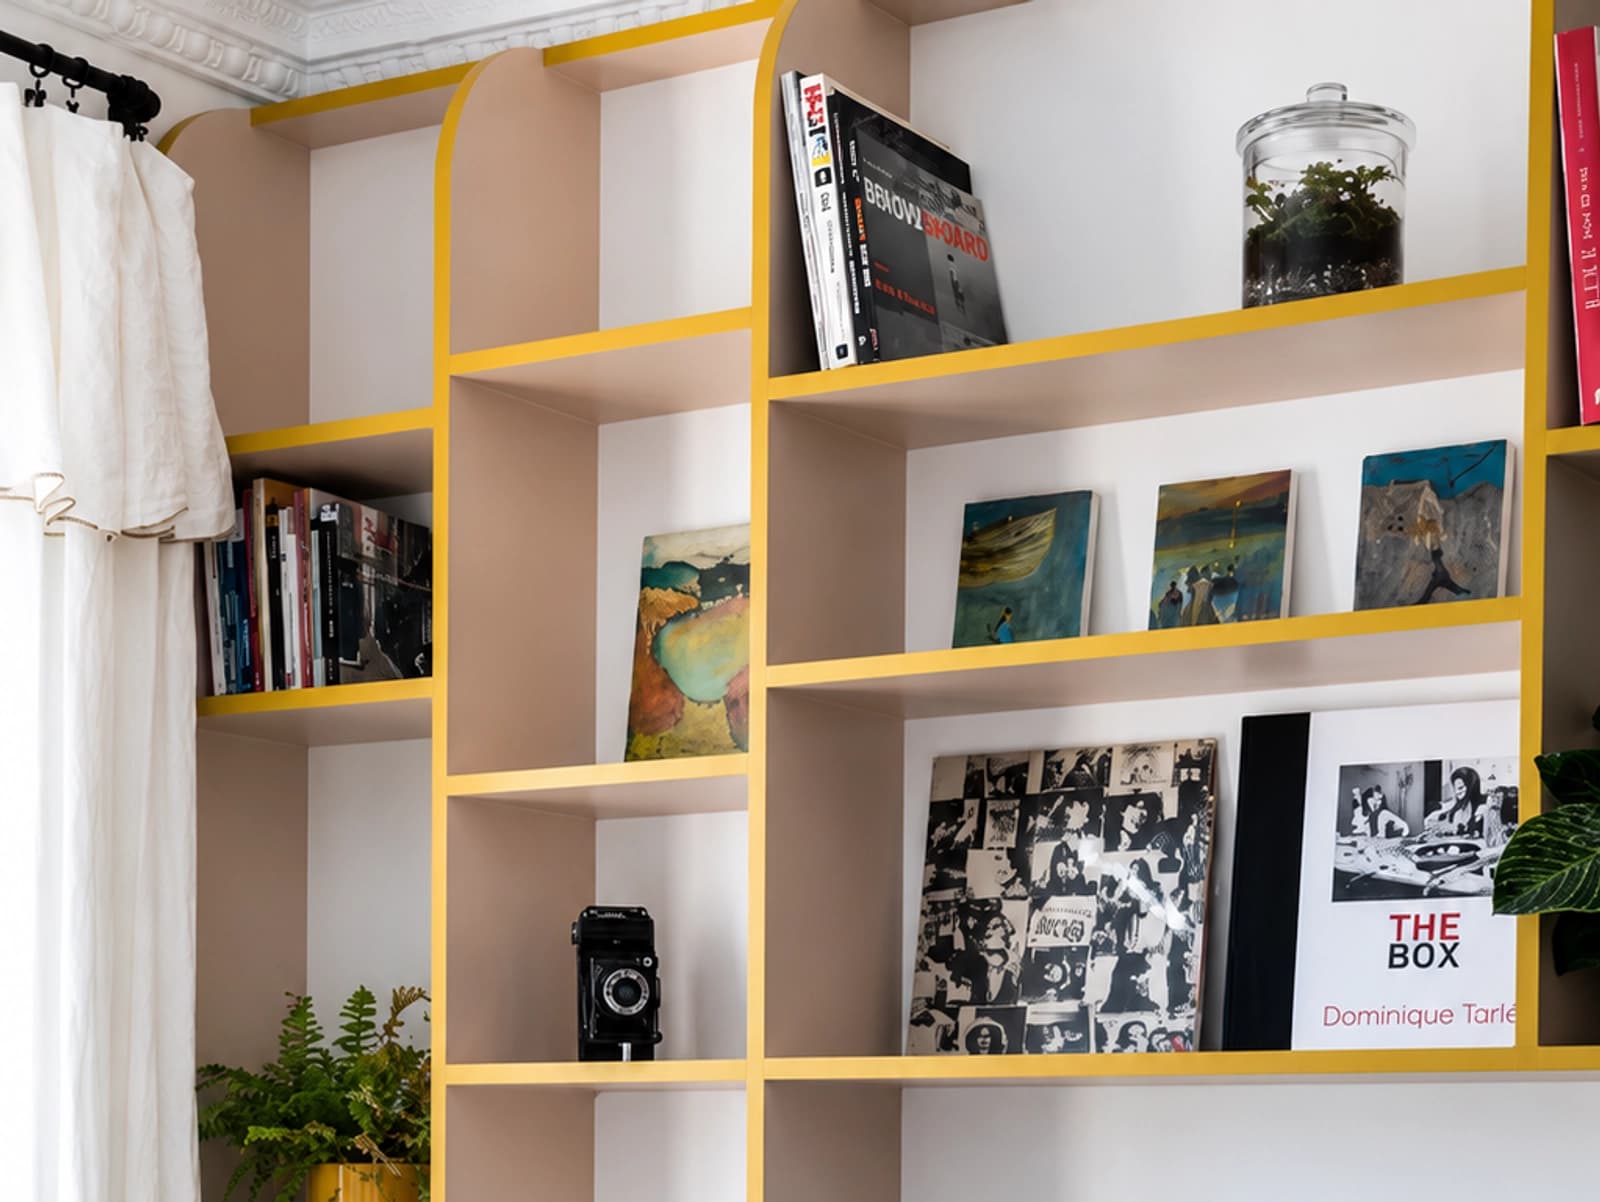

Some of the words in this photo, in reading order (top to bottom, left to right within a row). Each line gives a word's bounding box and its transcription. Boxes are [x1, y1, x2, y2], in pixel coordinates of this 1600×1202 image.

[1389, 912, 1461, 942] THE
[1388, 942, 1460, 969] BOX
[1323, 1004, 1454, 1029] Dominique
